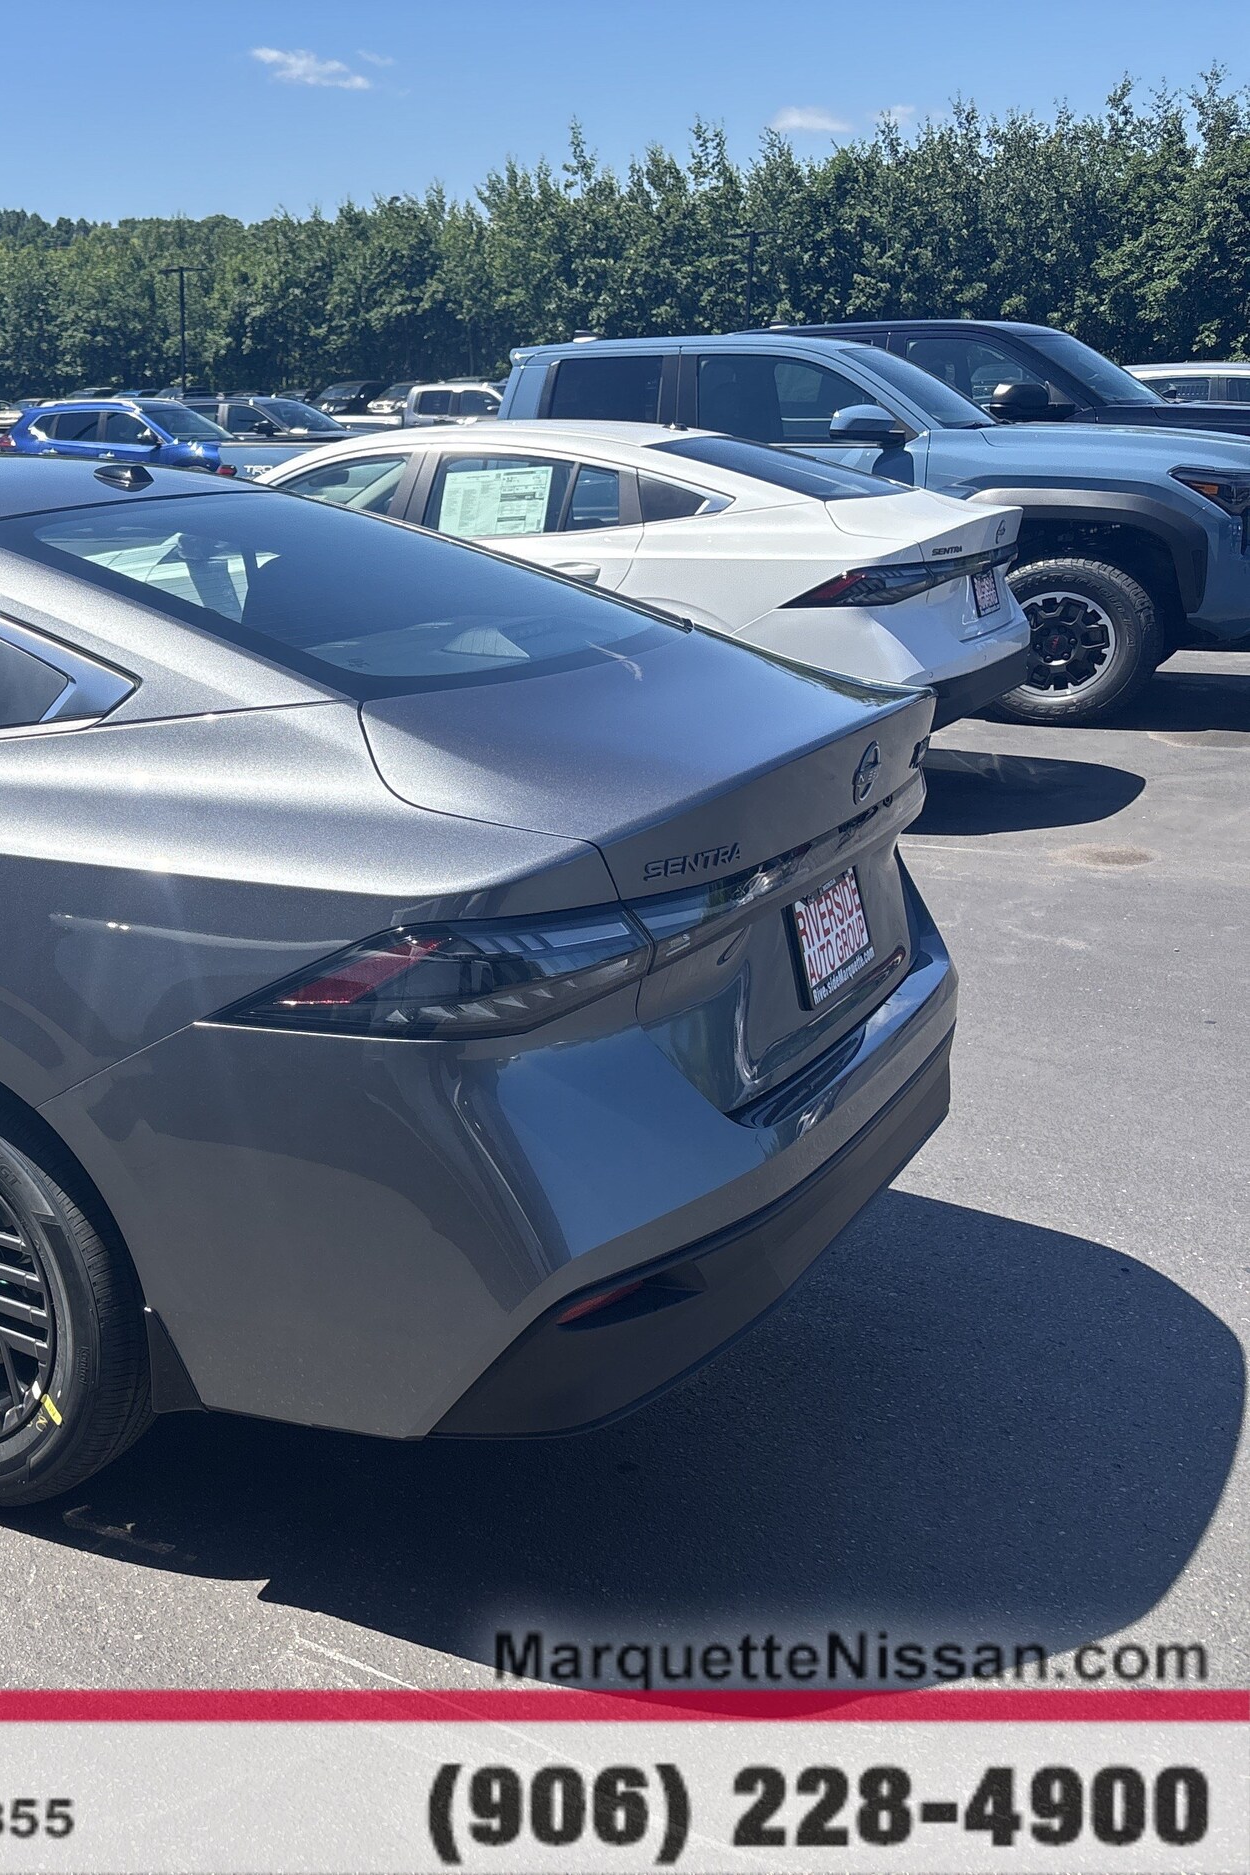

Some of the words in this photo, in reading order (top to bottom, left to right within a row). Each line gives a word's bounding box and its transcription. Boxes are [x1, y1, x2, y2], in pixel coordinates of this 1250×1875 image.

[932, 545, 962, 556] SENTRA
[643, 842, 741, 882] SENTRA
[795, 872, 862, 950] RIVERSIDE
[806, 936, 836, 988] AUTO
[834, 913, 866, 964] GROUP
